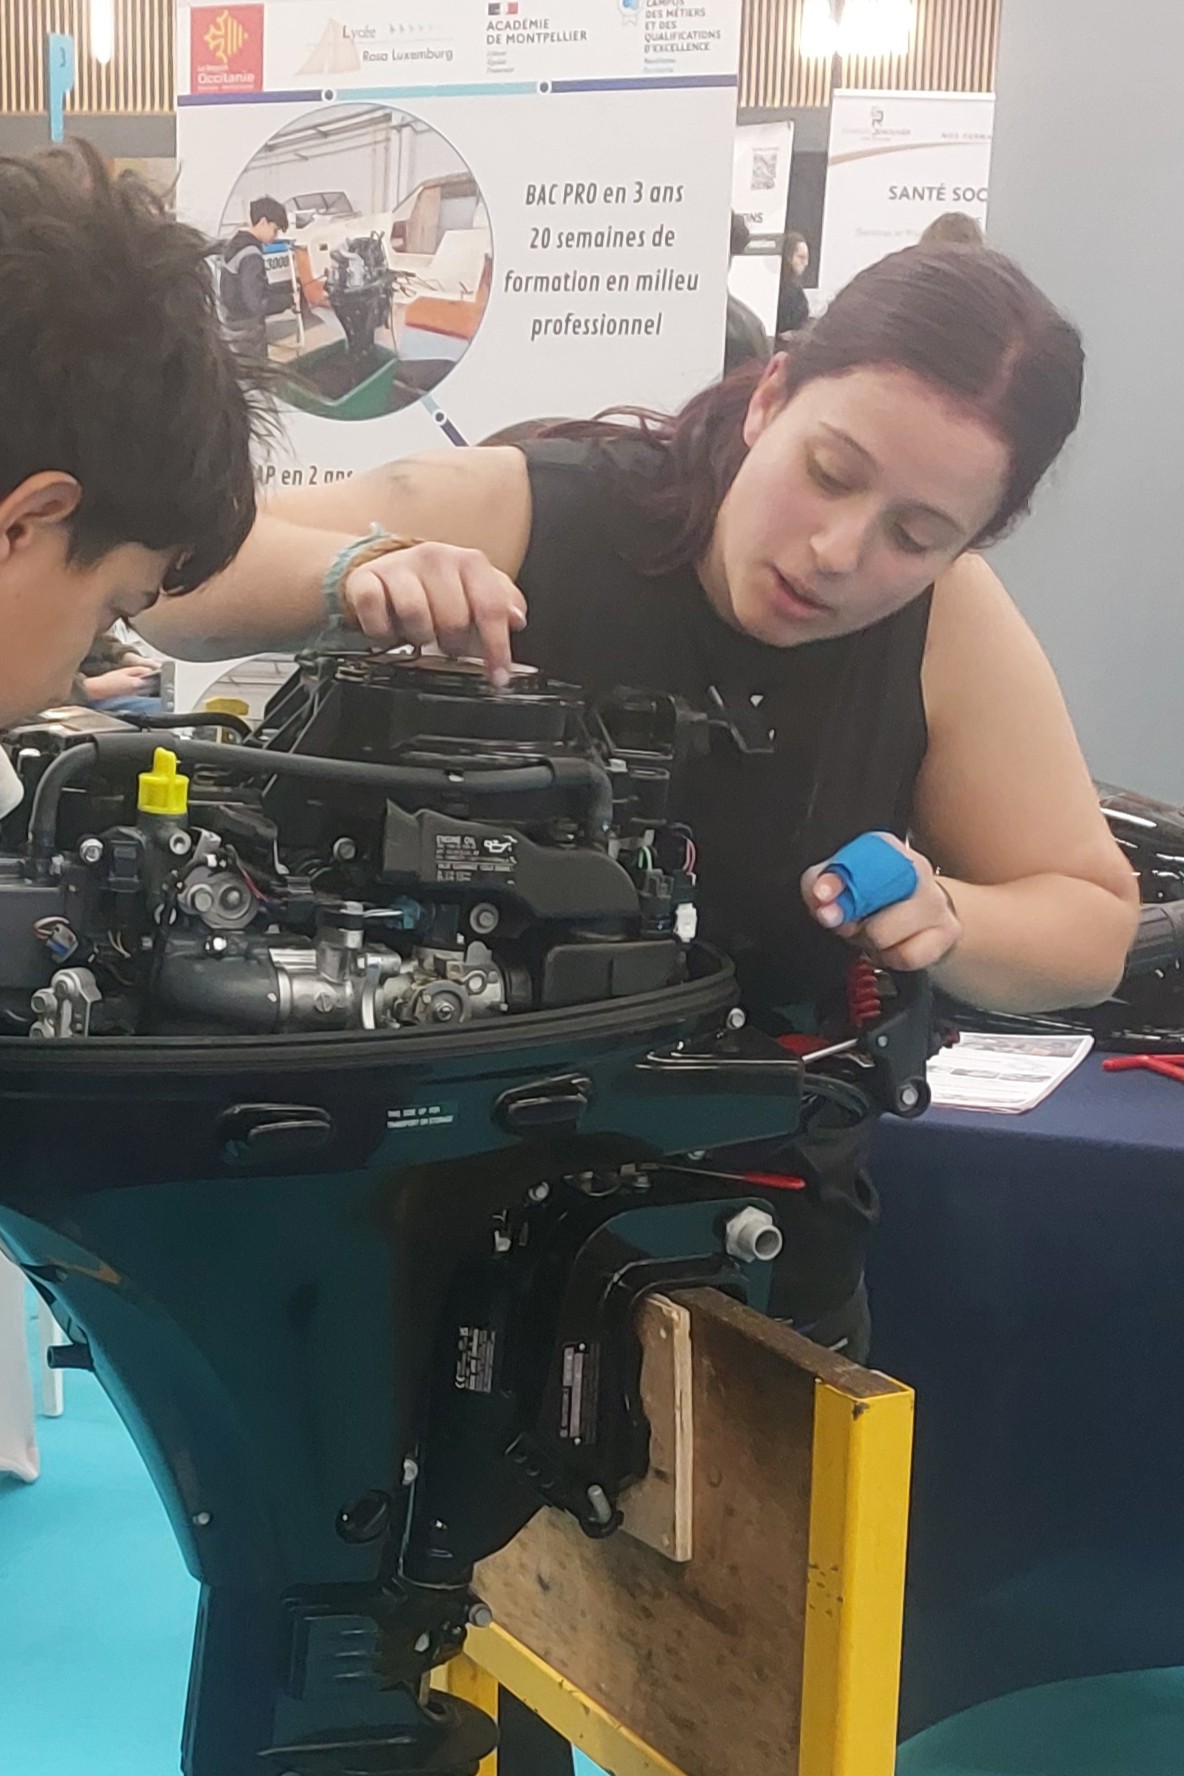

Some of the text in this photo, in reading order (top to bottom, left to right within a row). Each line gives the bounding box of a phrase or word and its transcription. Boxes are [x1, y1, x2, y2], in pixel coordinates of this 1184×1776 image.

[645, 9, 663, 19] DES
[486, 18, 550, 31] ACADÉMIE
[645, 21, 677, 31] ET DES
[486, 30, 587, 45] DE MONTPELLIER
[644, 30, 721, 43] QUALIFICATIONS
[362, 47, 454, 62] Rosa Luxemburg
[197, 70, 255, 84] Occitanie
[525, 181, 684, 206] BAC PRO en 3 ans
[888, 183, 947, 202] SANTÉ
[529, 223, 676, 249] 20 semaines de
[503, 267, 699, 293] formation en milieu
[530, 312, 663, 342] professionnel
[282, 469, 303, 486] en
[309, 465, 319, 486] 2
